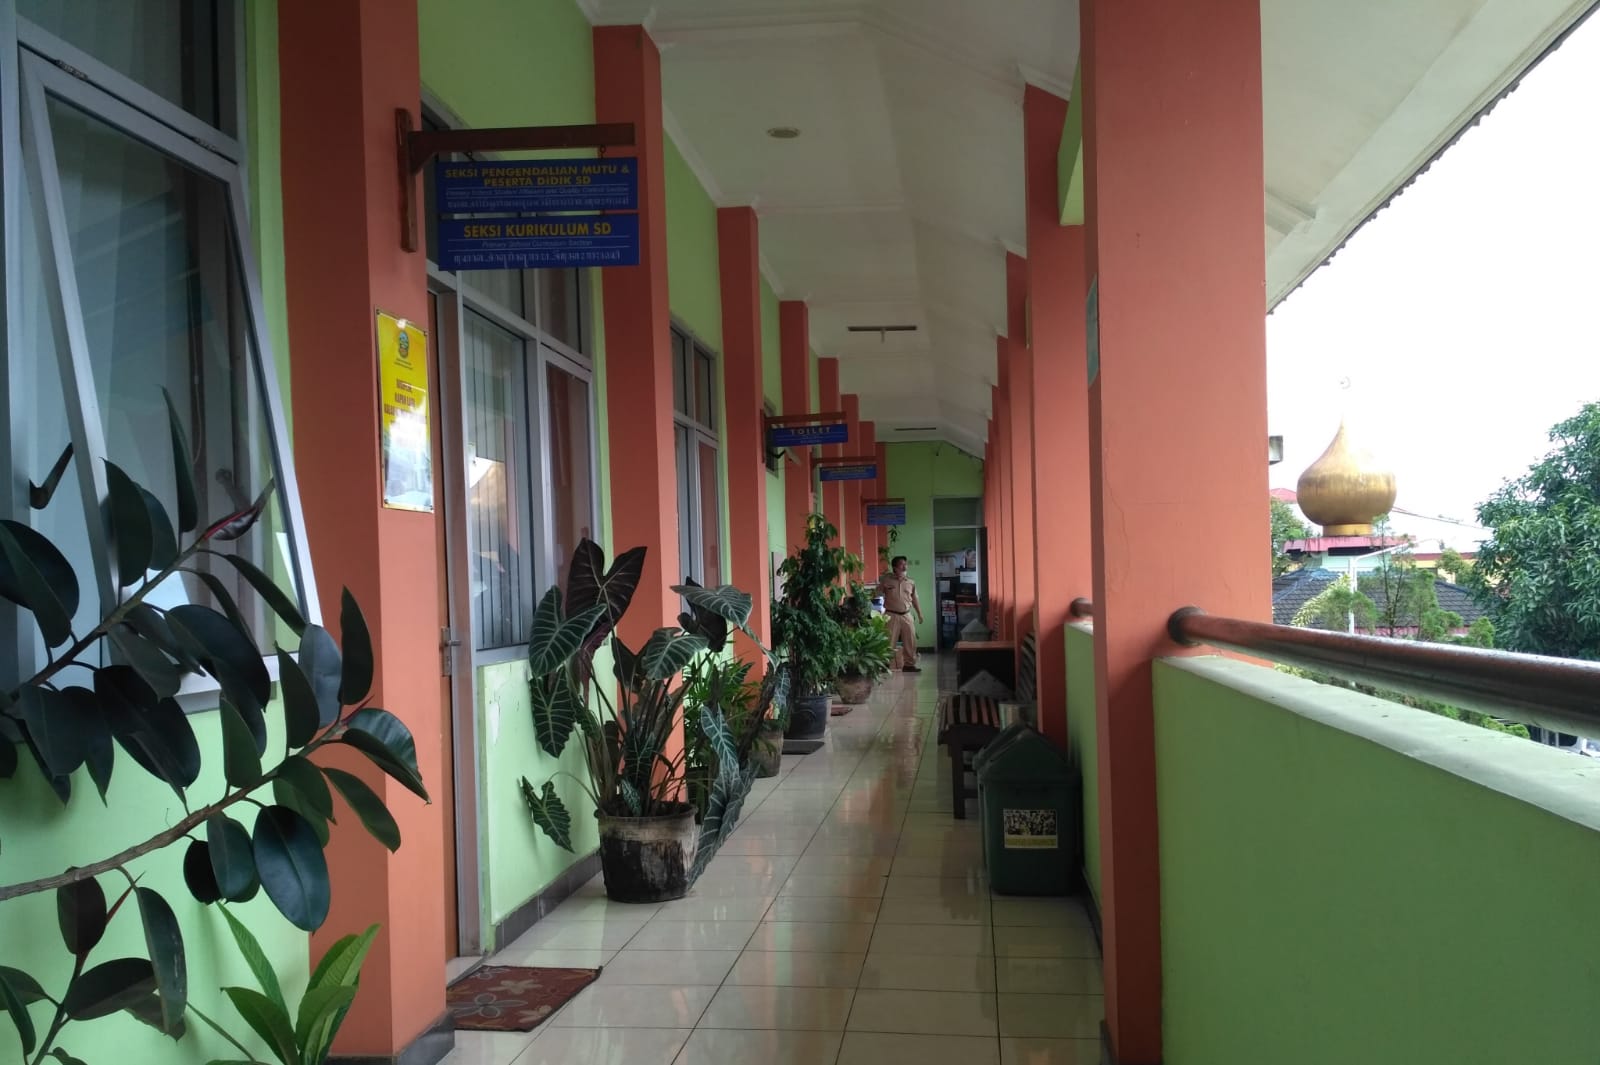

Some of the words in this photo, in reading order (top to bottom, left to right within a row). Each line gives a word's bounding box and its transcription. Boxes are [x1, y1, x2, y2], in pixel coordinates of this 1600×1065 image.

[445, 168, 478, 178] SEKSI
[482, 166, 577, 177] PENGENDALIAN
[582, 165, 617, 175] MUTU
[484, 177, 533, 187] PESERTA
[537, 176, 572, 186] DIDIK
[576, 175, 592, 185] SD
[464, 224, 501, 239] SEKSI
[506, 222, 589, 238] KURIKULUM
[593, 222, 612, 235] SD
[790, 427, 831, 436] TOILET
